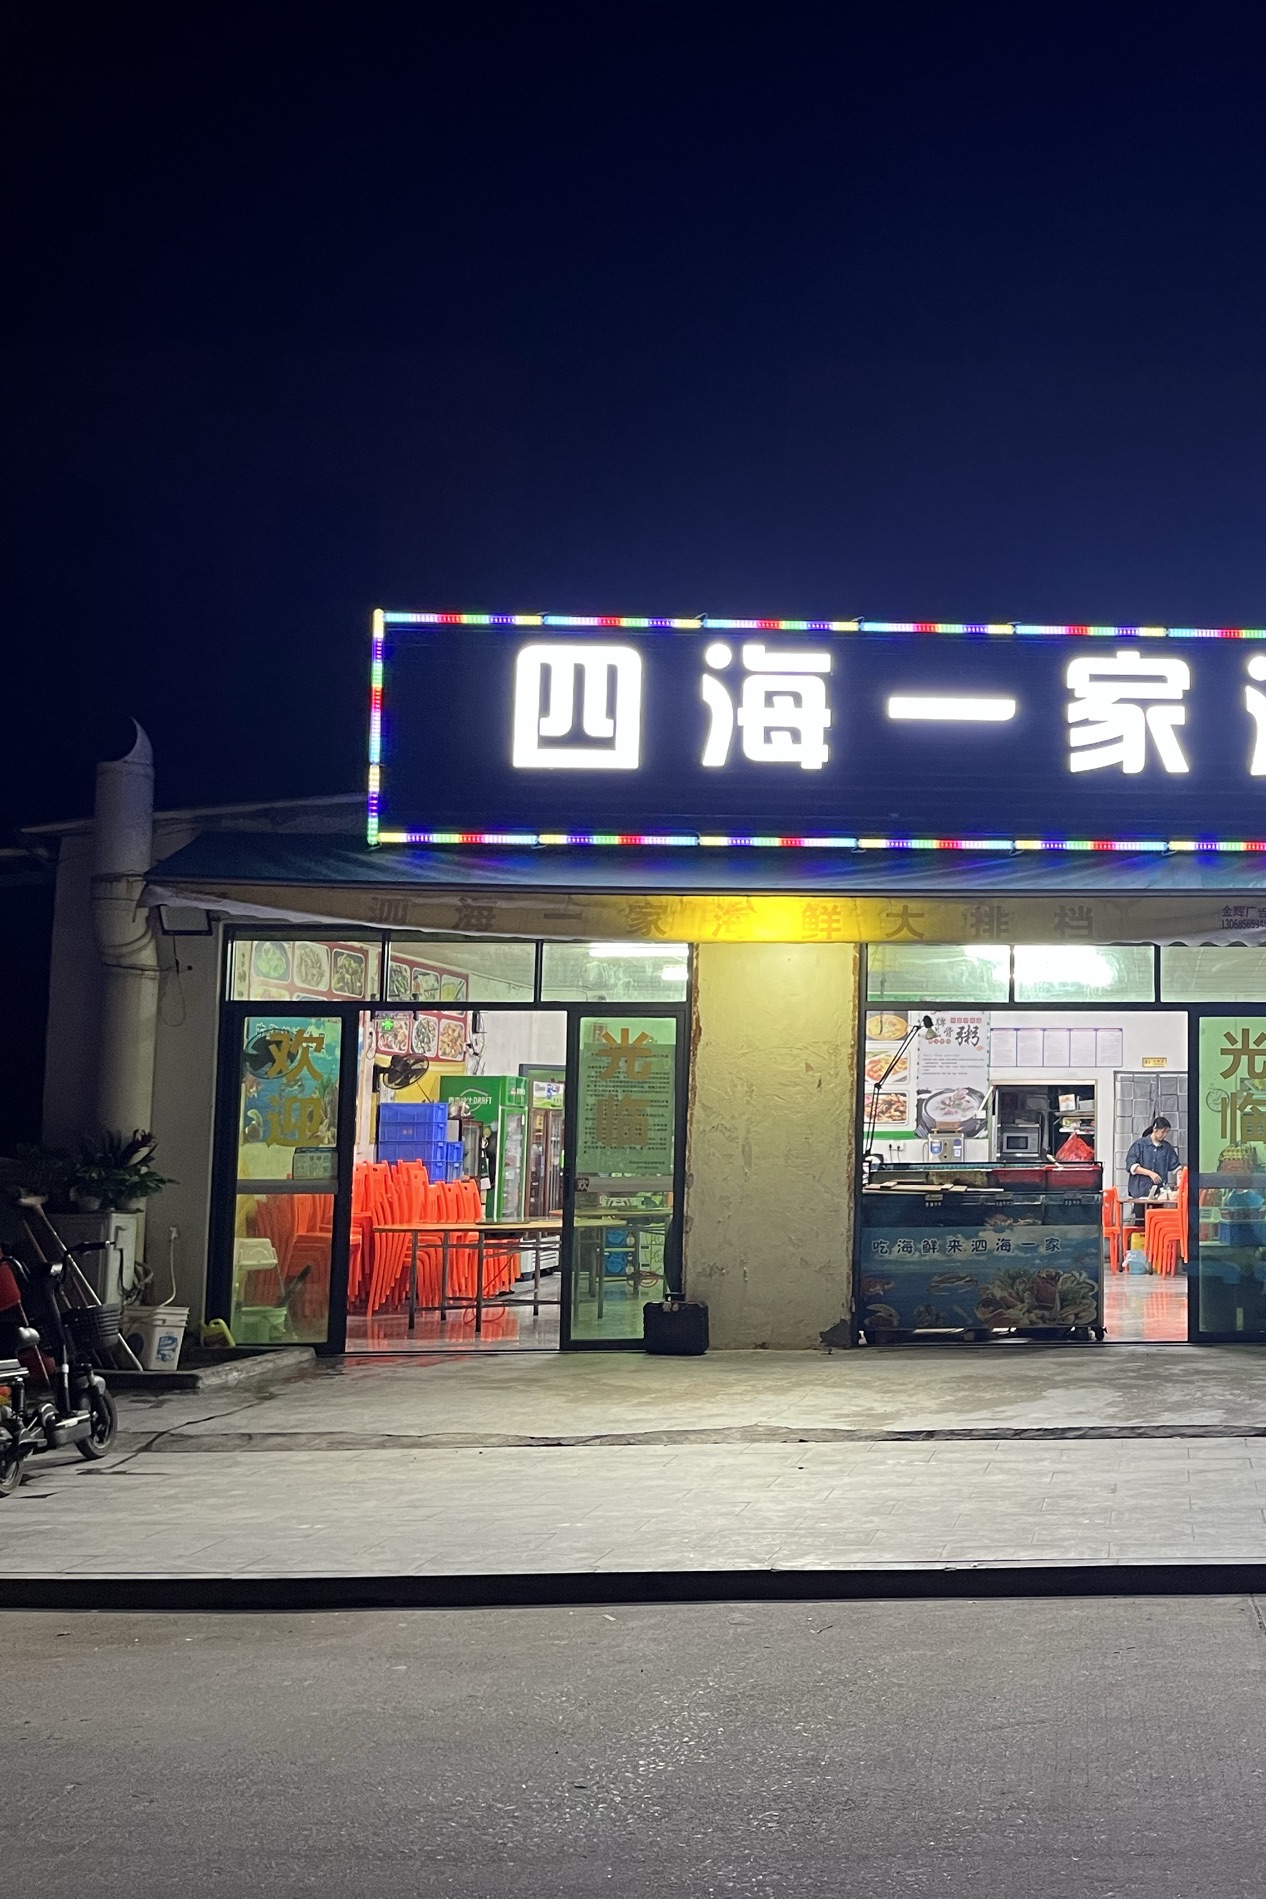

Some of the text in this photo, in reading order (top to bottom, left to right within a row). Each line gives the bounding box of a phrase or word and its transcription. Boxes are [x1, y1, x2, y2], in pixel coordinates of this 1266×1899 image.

[265, 1029, 325, 1148] 欢迎
[596, 1028, 652, 1147] 光临
[872, 1237, 1062, 1256] 吃海鲜来泗海一家
